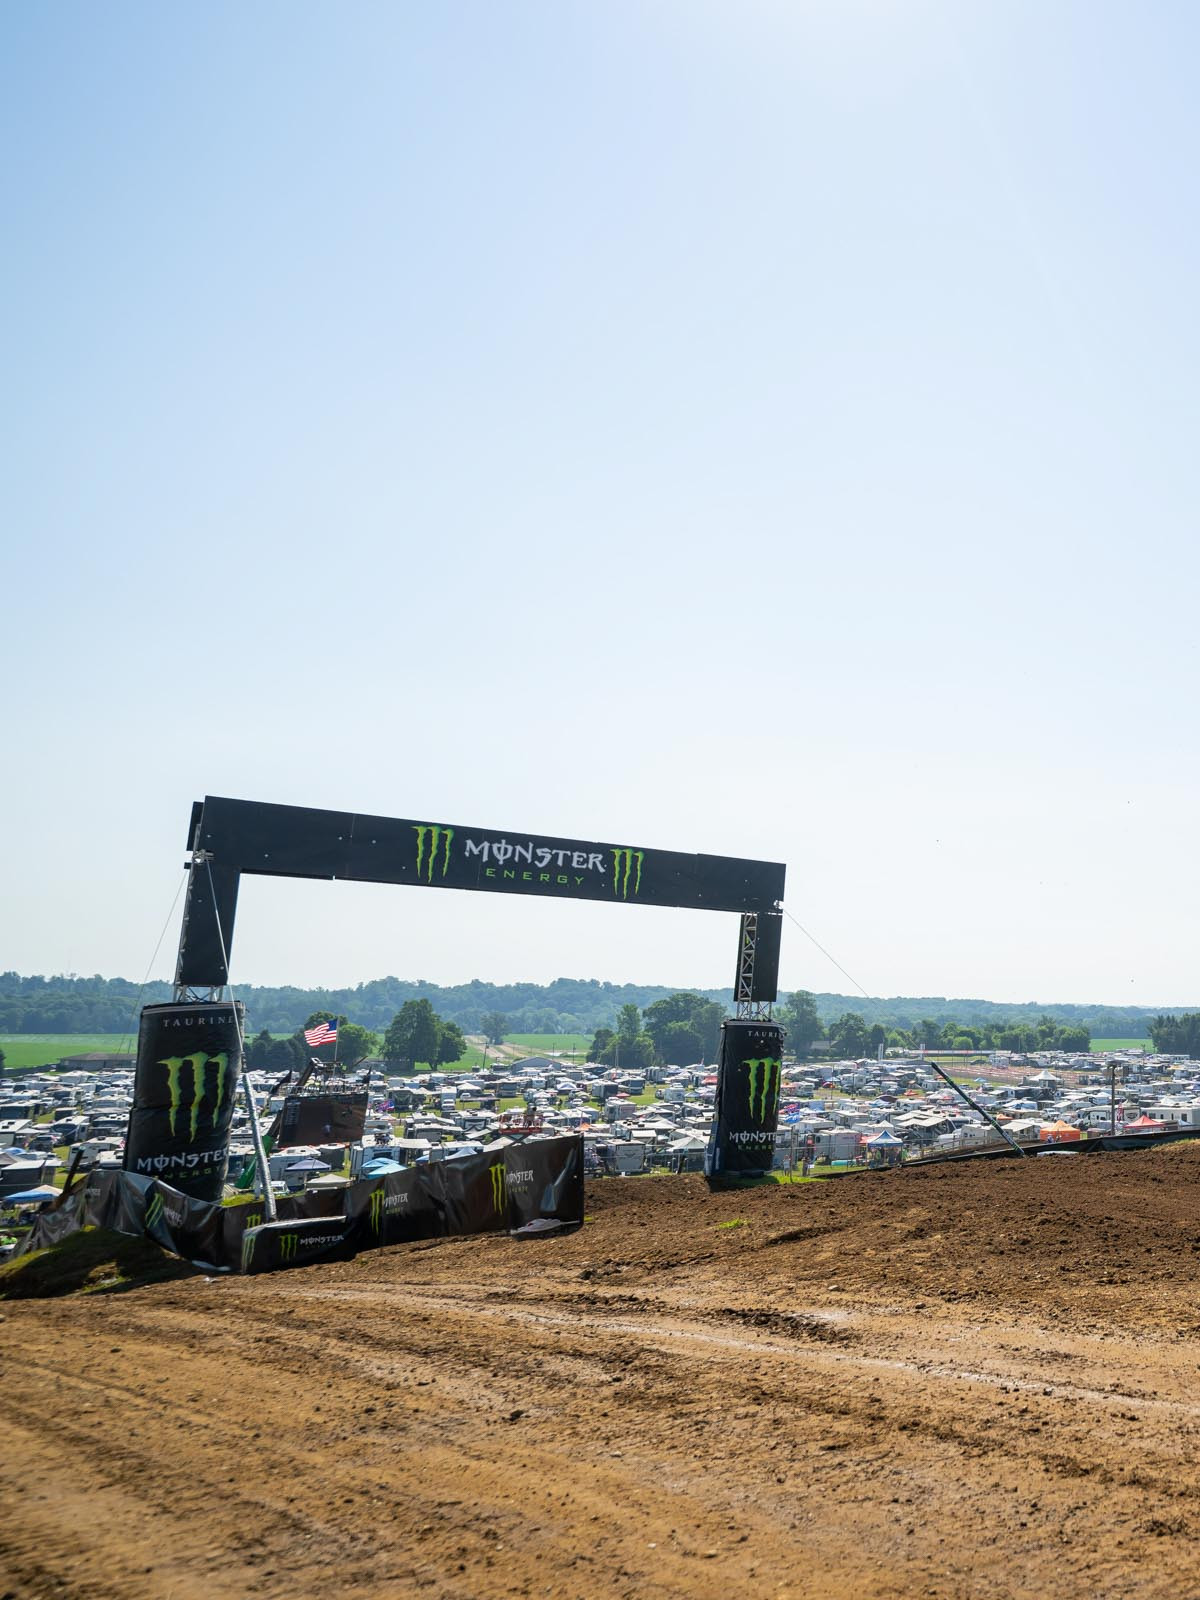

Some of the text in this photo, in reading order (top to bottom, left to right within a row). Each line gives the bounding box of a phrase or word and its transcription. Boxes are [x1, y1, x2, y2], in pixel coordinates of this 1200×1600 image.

[464, 838, 606, 872] MONSTER
[486, 868, 585, 885] ENERGY
[299, 1234, 344, 1246] MONSTER
